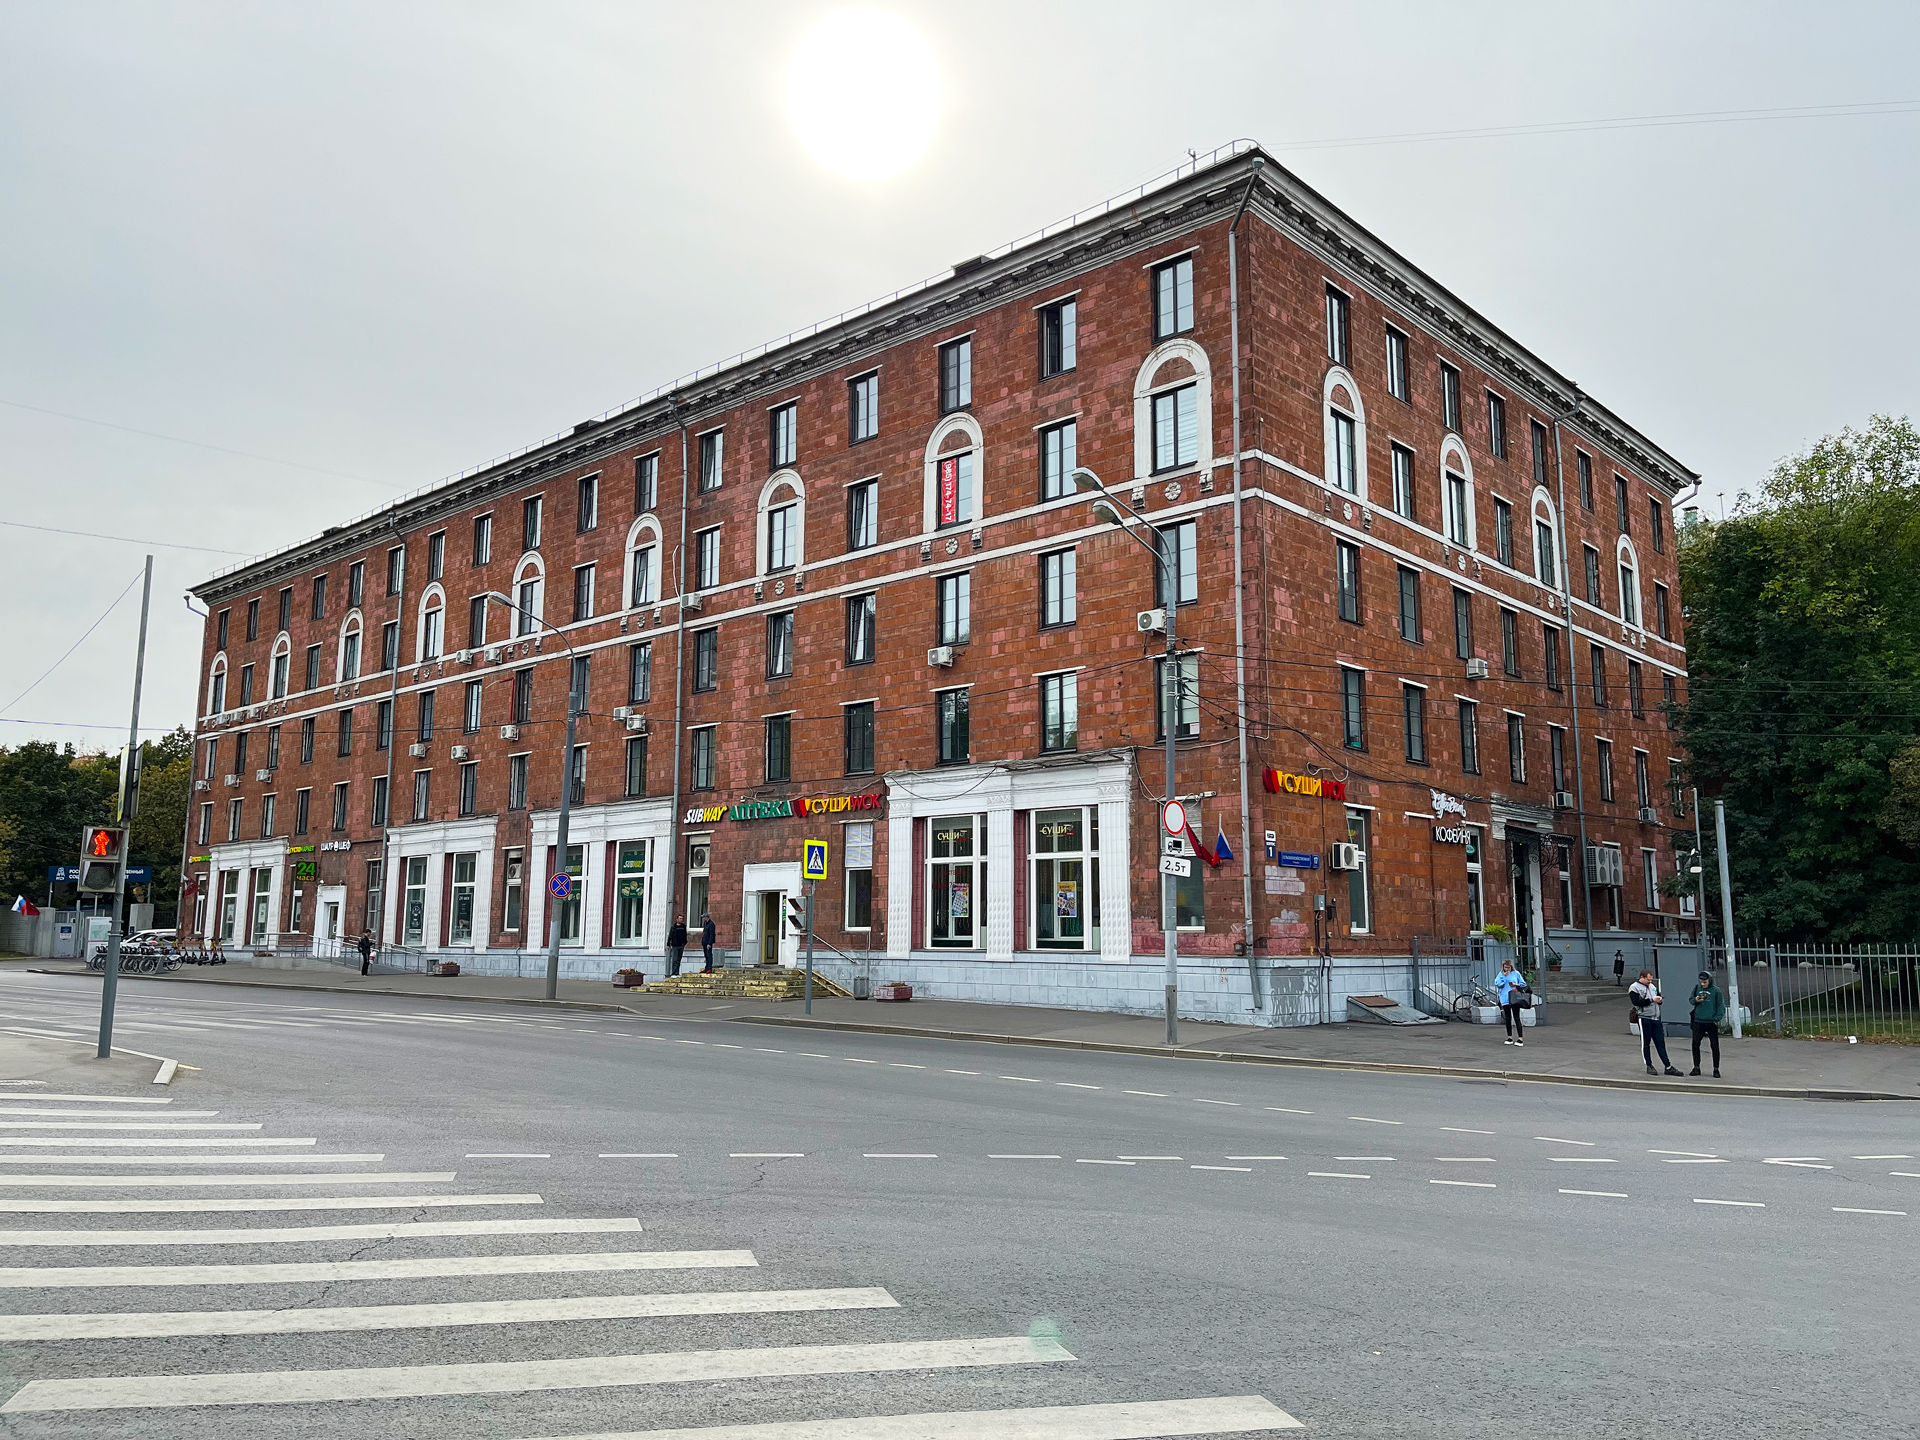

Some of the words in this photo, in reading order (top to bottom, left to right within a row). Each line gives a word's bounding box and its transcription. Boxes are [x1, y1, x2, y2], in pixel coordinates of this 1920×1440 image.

[684, 806, 728, 824] SUBWAY
[728, 801, 793, 820] АПТЕКА
[1436, 826, 1471, 845] КОФЕЙНЯ
[297, 862, 315, 875] 24
